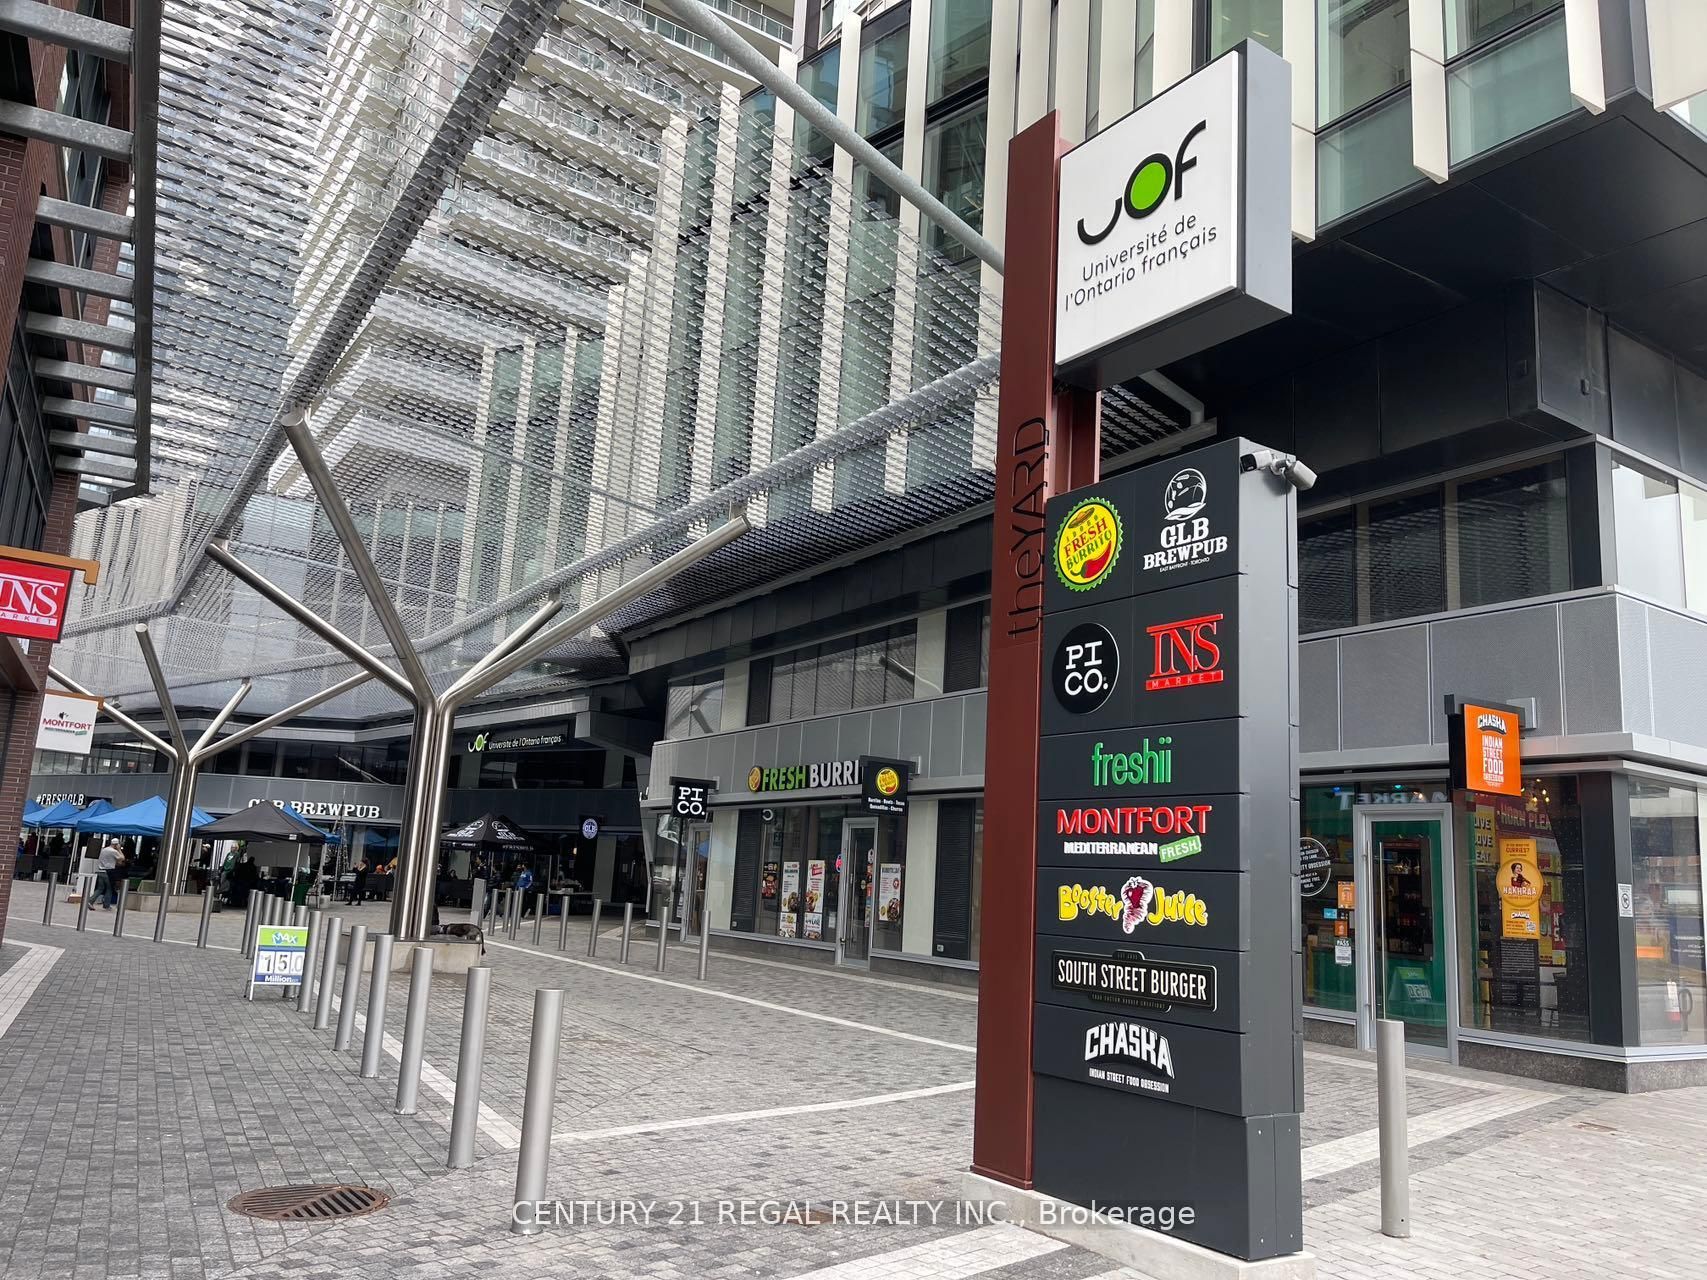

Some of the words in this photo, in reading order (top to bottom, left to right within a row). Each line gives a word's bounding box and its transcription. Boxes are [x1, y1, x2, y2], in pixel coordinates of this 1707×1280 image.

[1082, 224, 1167, 281] Université
[1174, 213, 1197, 235] de
[1065, 266, 1135, 312] l'Ontario
[1142, 226, 1217, 276] français
[1064, 517, 1107, 558] FRESH
[1161, 517, 1209, 548] GLB
[1066, 530, 1112, 570] BURRITO
[1143, 536, 1228, 570] BREWPUB
[1065, 640, 1103, 670] PI
[1149, 621, 1221, 678] INS
[1064, 668, 1109, 696] CO.
[1152, 672, 1217, 688] MARKET
[43, 718, 92, 730] MONTFORT
[1482, 735, 1502, 749] INDIAN
[1483, 747, 1503, 760] STREET
[1092, 736, 1172, 786] freshii
[1483, 758, 1503, 774] FOOD
[762, 765, 806, 791] FRESH
[677, 801, 705, 815] CO.
[678, 786, 703, 801] PI
[290, 800, 380, 818] BREWPUB
[1056, 805, 1213, 834] MONTFORT
[1064, 841, 1159, 855] MEDITERRANEAN
[1160, 838, 1199, 861] FRESH
[1058, 883, 1124, 921] Booster
[1147, 886, 1208, 926] Juice
[1058, 959, 1097, 987] SOUTH
[1101, 964, 1147, 993] STREET
[1151, 969, 1207, 1001] BURGER
[1085, 1022, 1175, 1079] CHASKA
[1089, 1067, 1105, 1079] INDIAN
[1106, 1071, 1125, 1084] STREET
[1126, 1075, 1139, 1087] FOOD
[1140, 1078, 1170, 1093] OBSESSION
